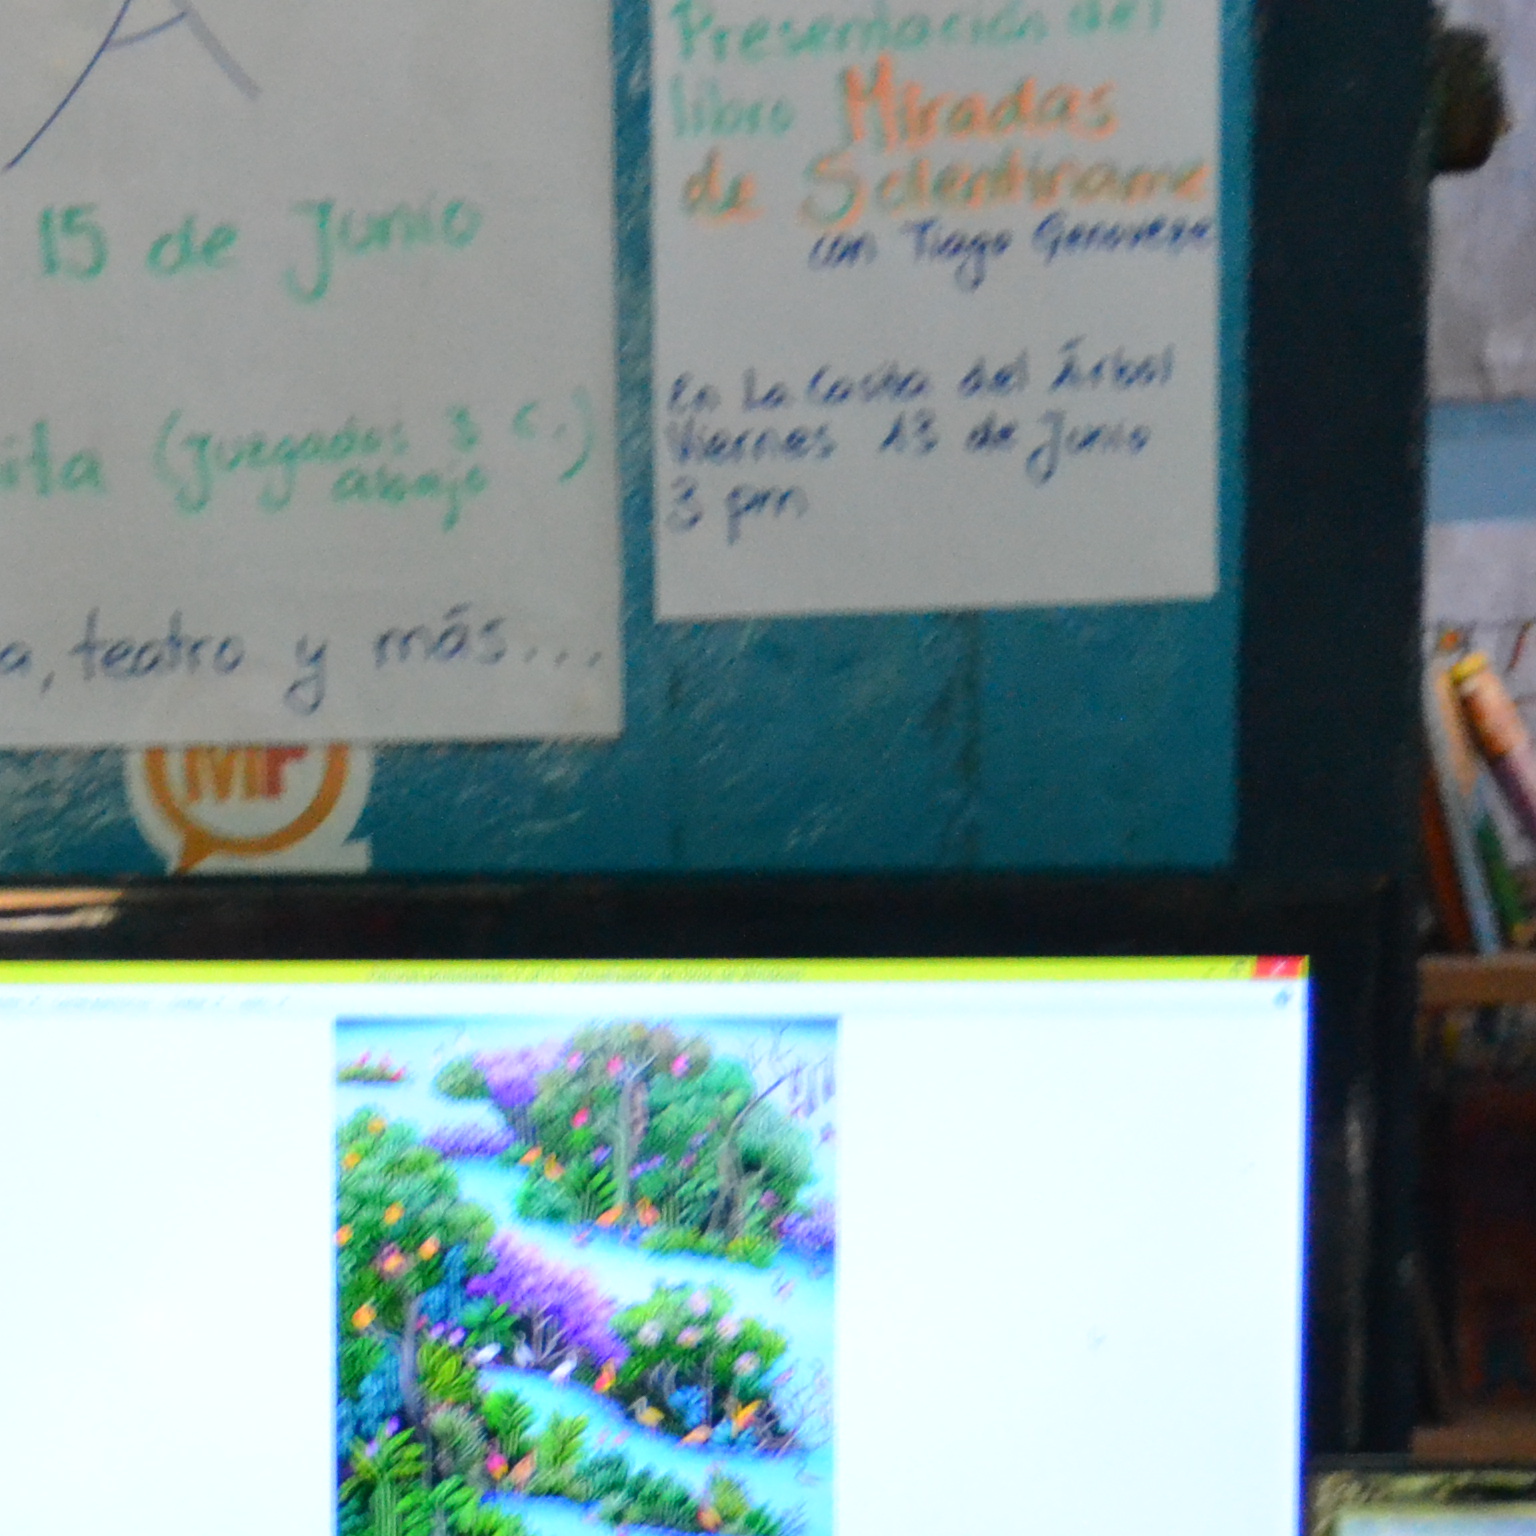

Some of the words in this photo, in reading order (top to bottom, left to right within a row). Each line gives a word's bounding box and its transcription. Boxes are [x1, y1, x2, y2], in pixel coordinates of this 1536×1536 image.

[838, 52, 1120, 150] Miradas
[682, 145, 766, 232] de
[38, 203, 109, 282] 15
[146, 212, 239, 276] de
[283, 195, 483, 303] Junio
[958, 350, 1030, 397] del
[964, 408, 1021, 455] de
[666, 475, 704, 534] 3
[725, 484, 810, 546] pm
[68, 605, 248, 682] teatro
[283, 633, 328, 717] y
